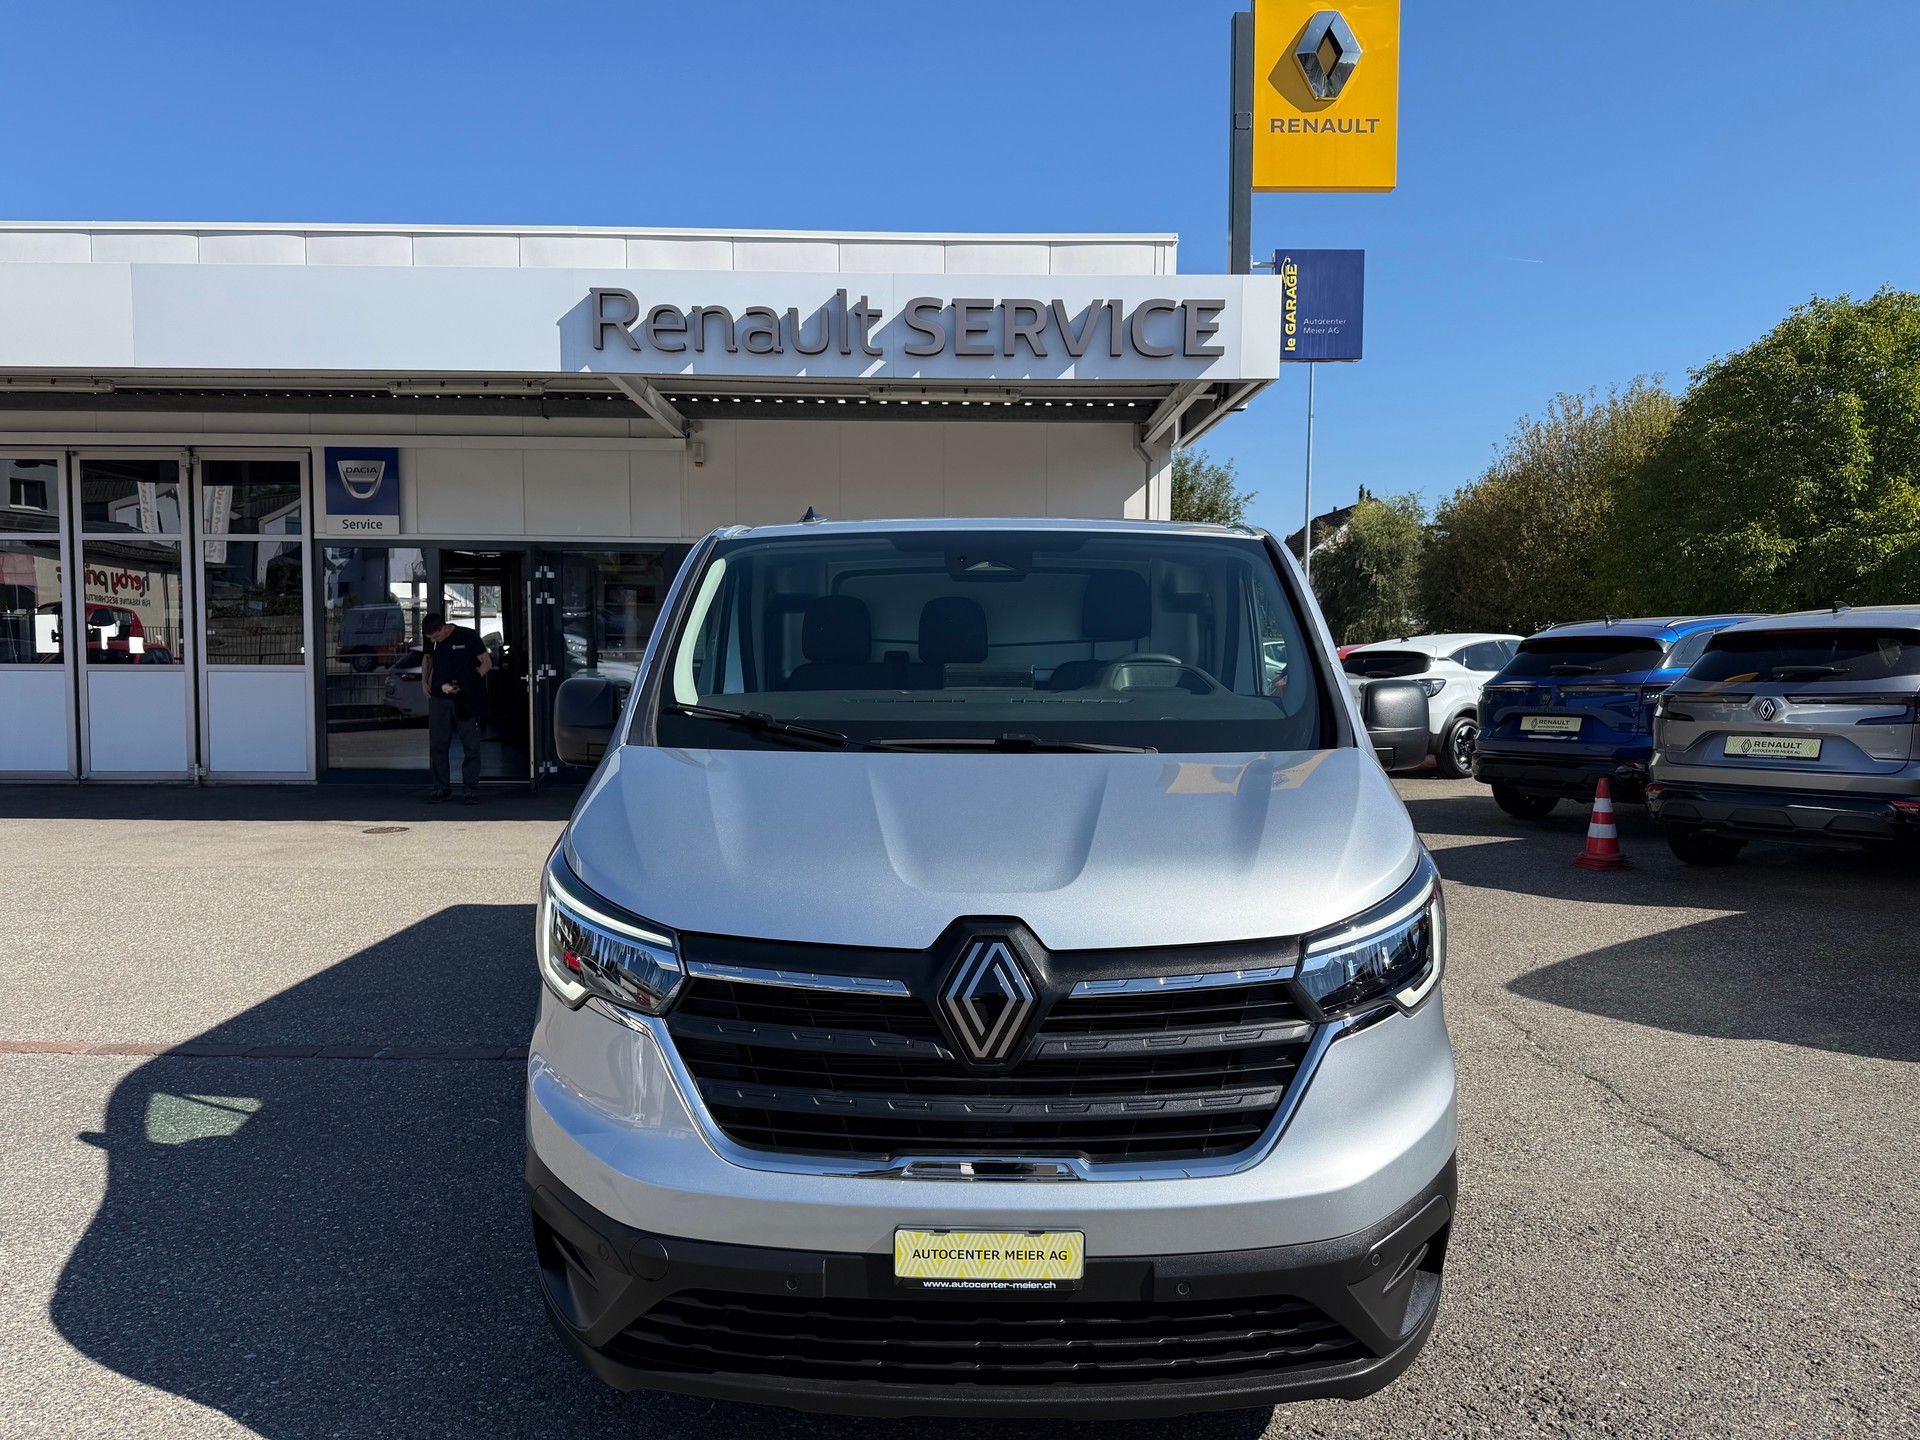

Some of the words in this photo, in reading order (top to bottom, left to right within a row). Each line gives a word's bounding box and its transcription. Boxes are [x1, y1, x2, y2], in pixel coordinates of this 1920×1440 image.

[1270, 118, 1380, 133] RENAULT
[1285, 263, 1298, 335] GARAGE
[588, 287, 883, 357] Renault
[904, 296, 1226, 357] SERVICE
[1285, 338, 1296, 351] le
[342, 519, 383, 530] Service
[1753, 741, 1802, 749] RENAULT
[912, 1249, 1000, 1261] AUTOCENTER
[1004, 1250, 1045, 1261] MEIER
[1049, 1251, 1068, 1261] AG
[923, 1280, 1056, 1289] www.autocenter-meier.ch
